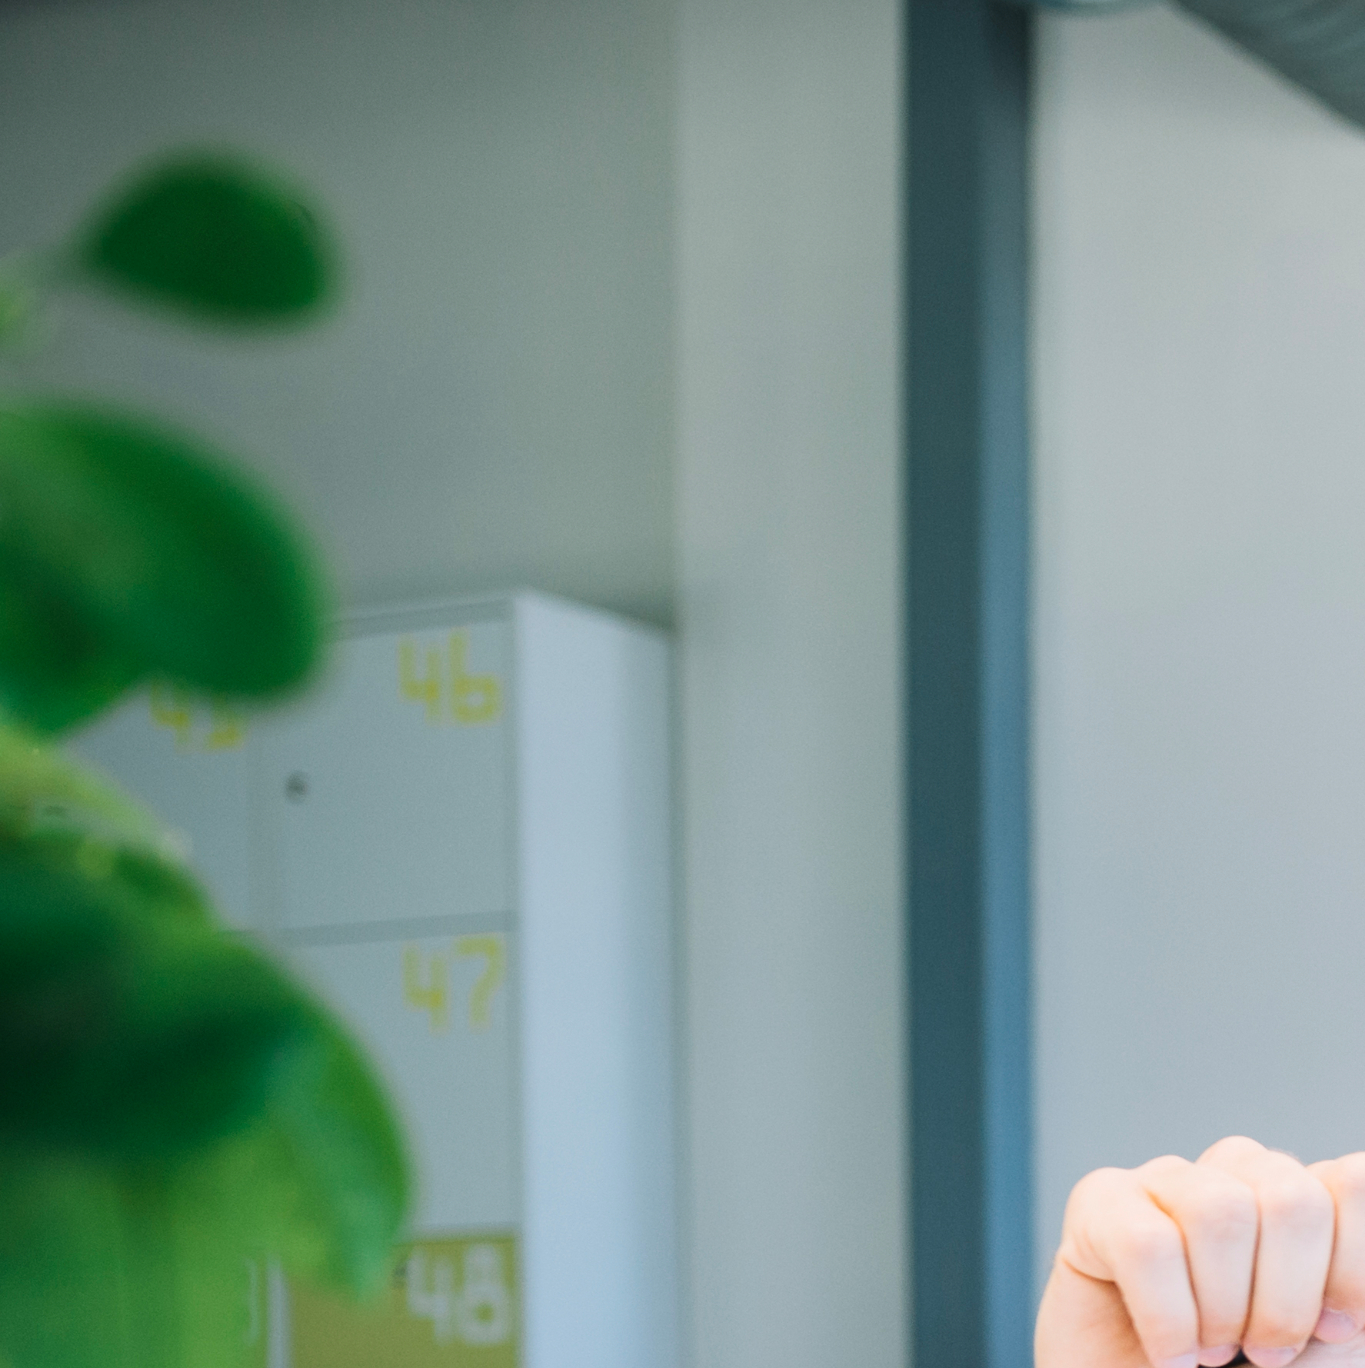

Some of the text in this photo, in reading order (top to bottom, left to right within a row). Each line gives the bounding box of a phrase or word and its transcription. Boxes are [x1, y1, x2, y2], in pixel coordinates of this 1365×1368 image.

[399, 629, 502, 726] 46
[403, 932, 504, 1032] 47
[406, 1243, 510, 1346] 48
